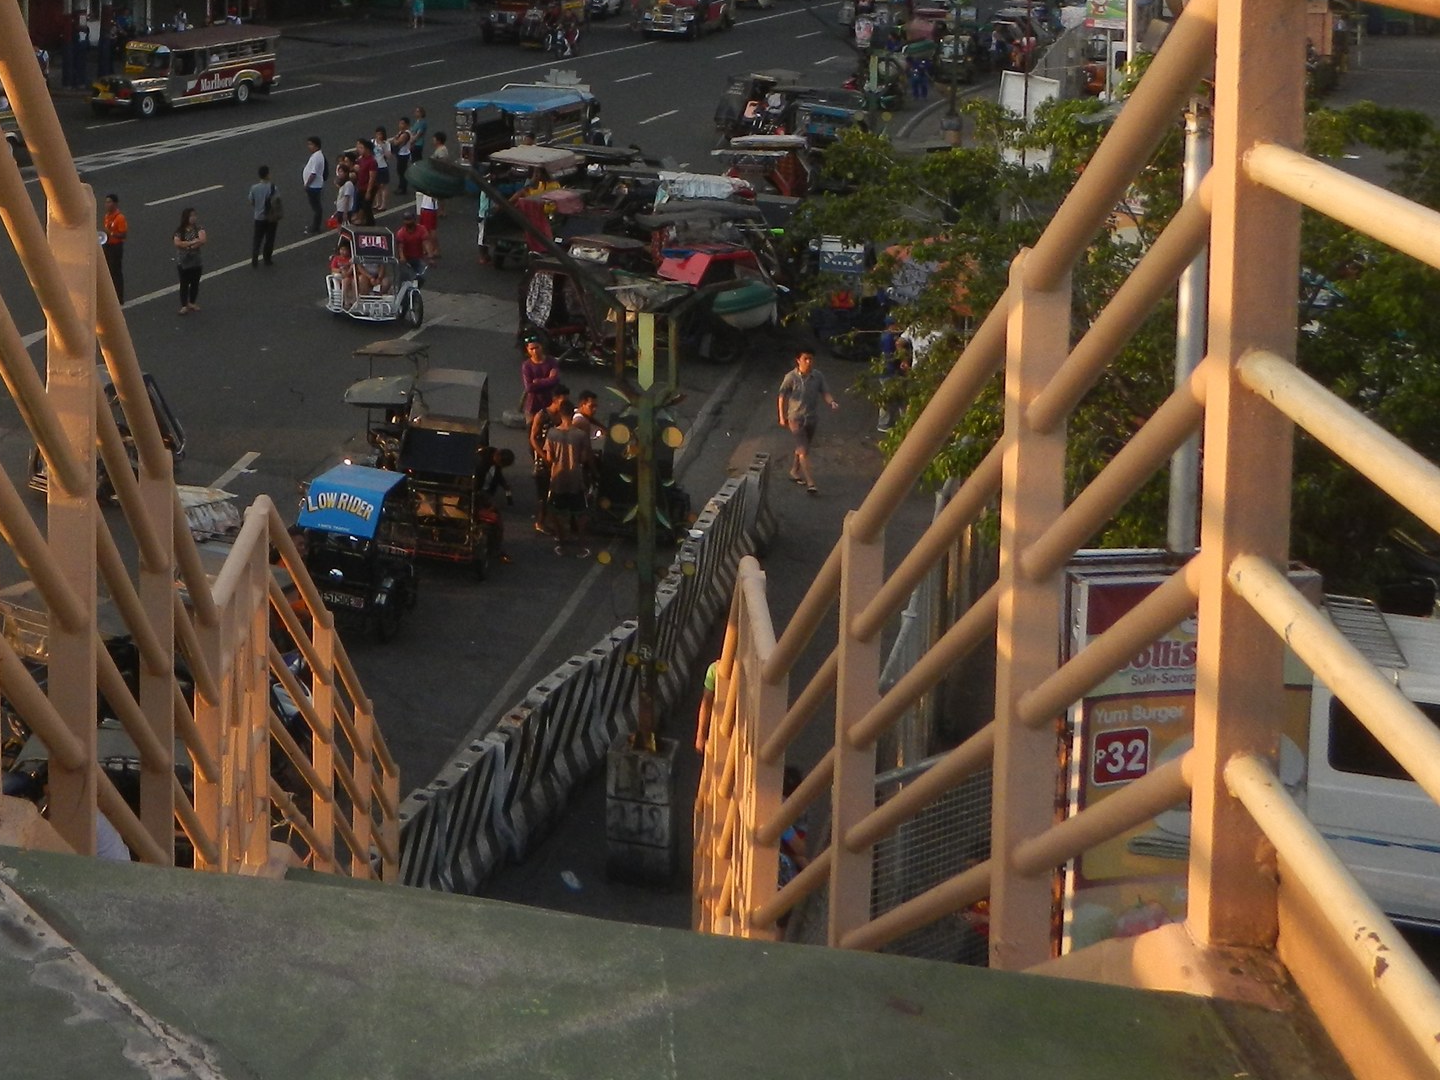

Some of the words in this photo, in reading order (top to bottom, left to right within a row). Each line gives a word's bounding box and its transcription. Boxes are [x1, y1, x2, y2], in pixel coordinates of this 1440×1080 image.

[200, 73, 234, 92] Marlboro
[307, 492, 337, 512] LOW
[337, 493, 374, 521] RIDER
[1096, 708, 1128, 723] Yum
[1132, 704, 1185, 723] Burger
